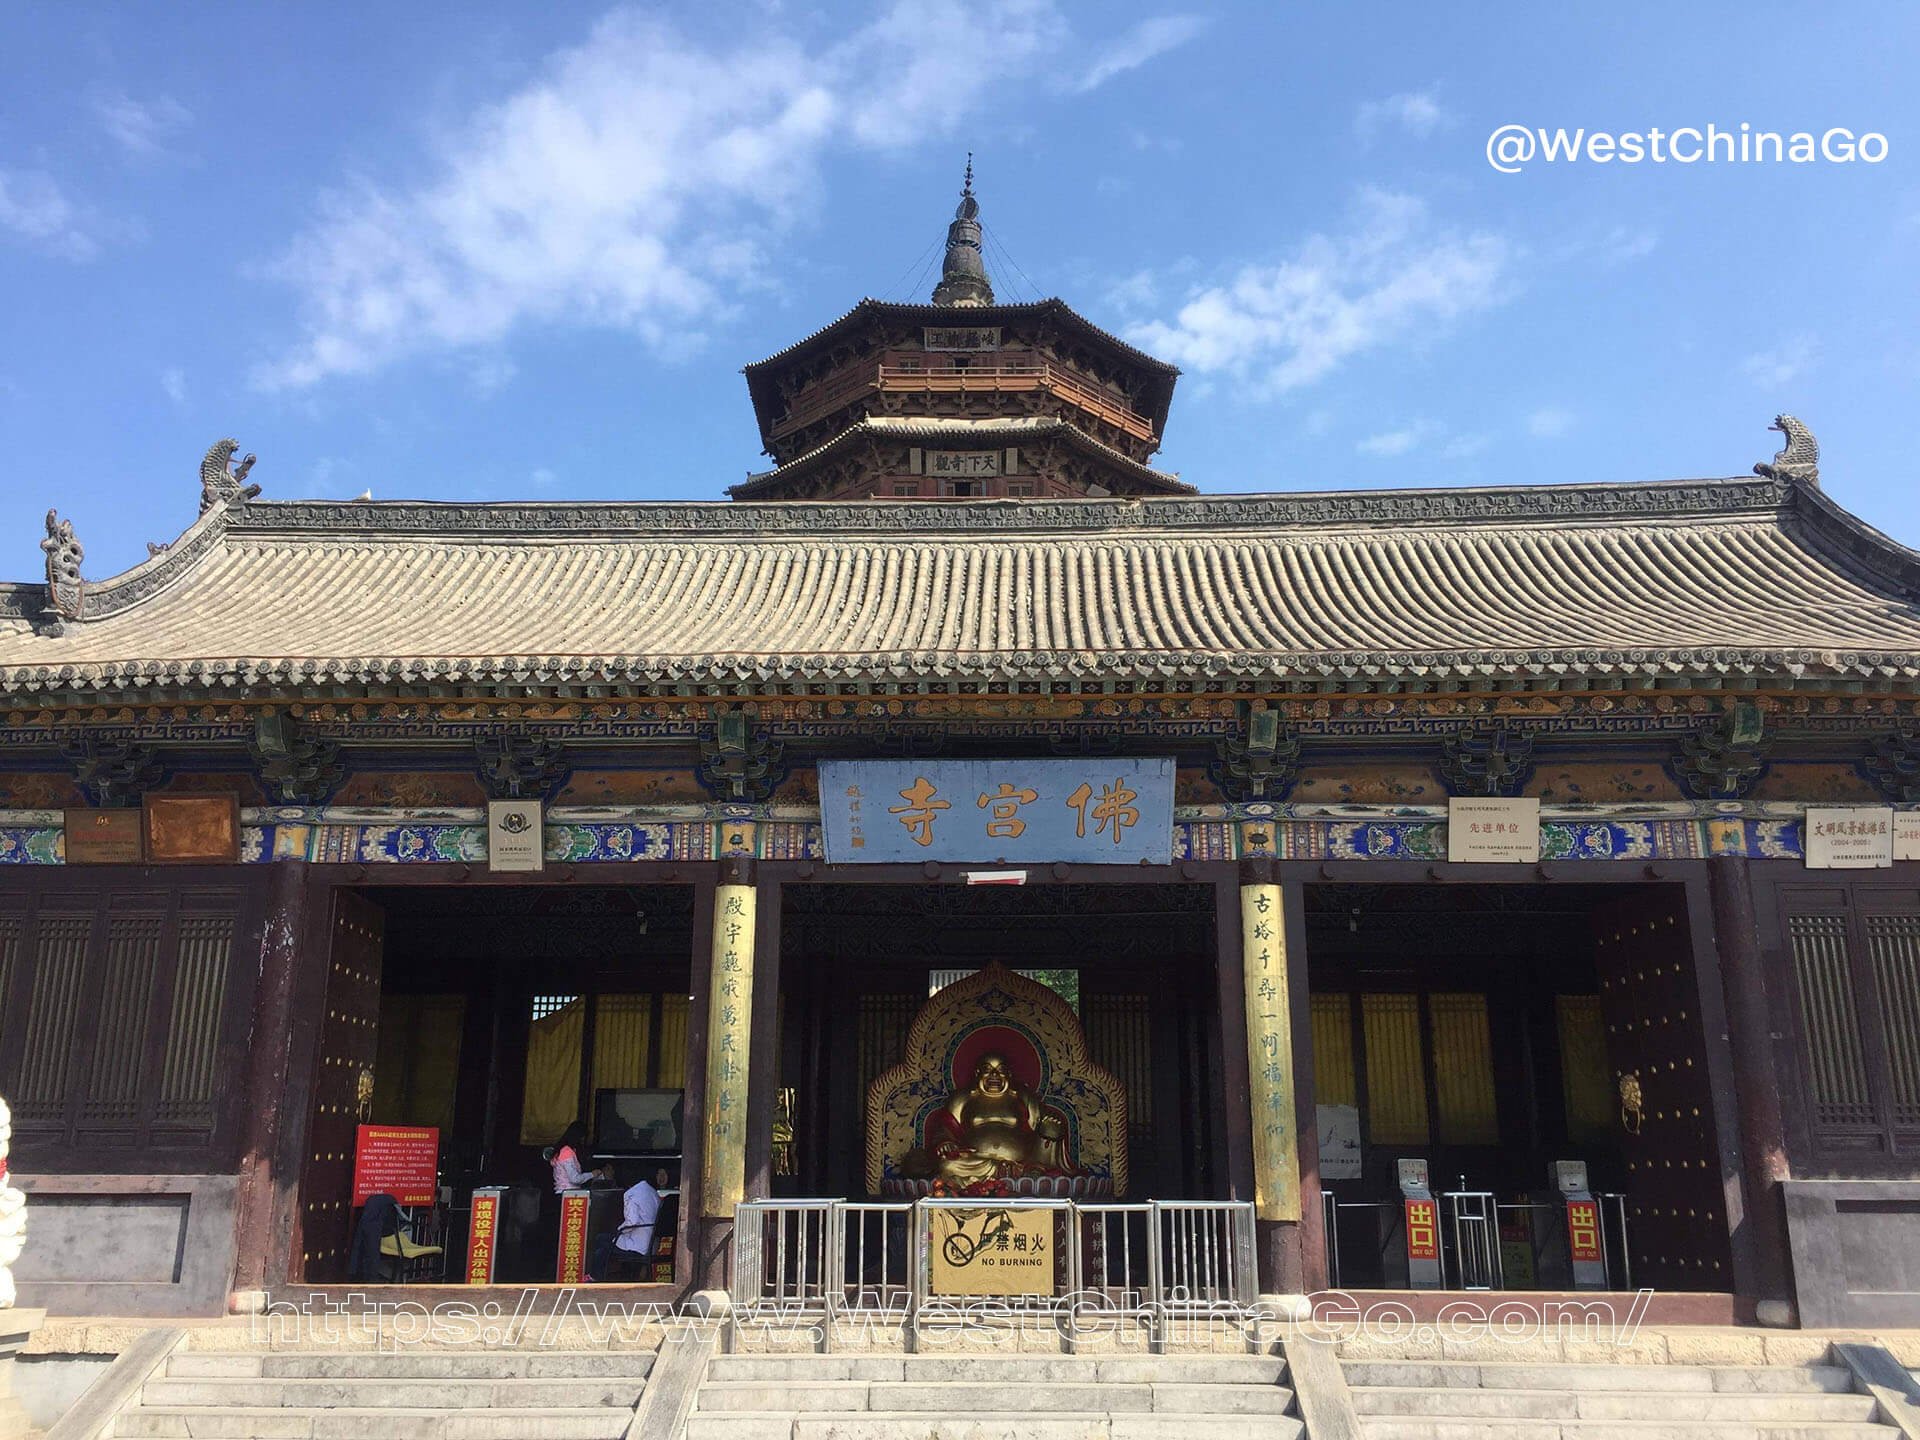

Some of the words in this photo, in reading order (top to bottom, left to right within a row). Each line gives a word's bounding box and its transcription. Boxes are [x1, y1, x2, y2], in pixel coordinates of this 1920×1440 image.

[934, 454, 997, 472] 天下奇觀
[1469, 822, 1521, 834] 先进单位
[1813, 820, 1888, 837] 文明风景旅游区
[1410, 1204, 1433, 1246] 出口
[1571, 1206, 1596, 1249] 出口
[981, 1257, 995, 1266] NO
[999, 1257, 1043, 1266] BURNING
